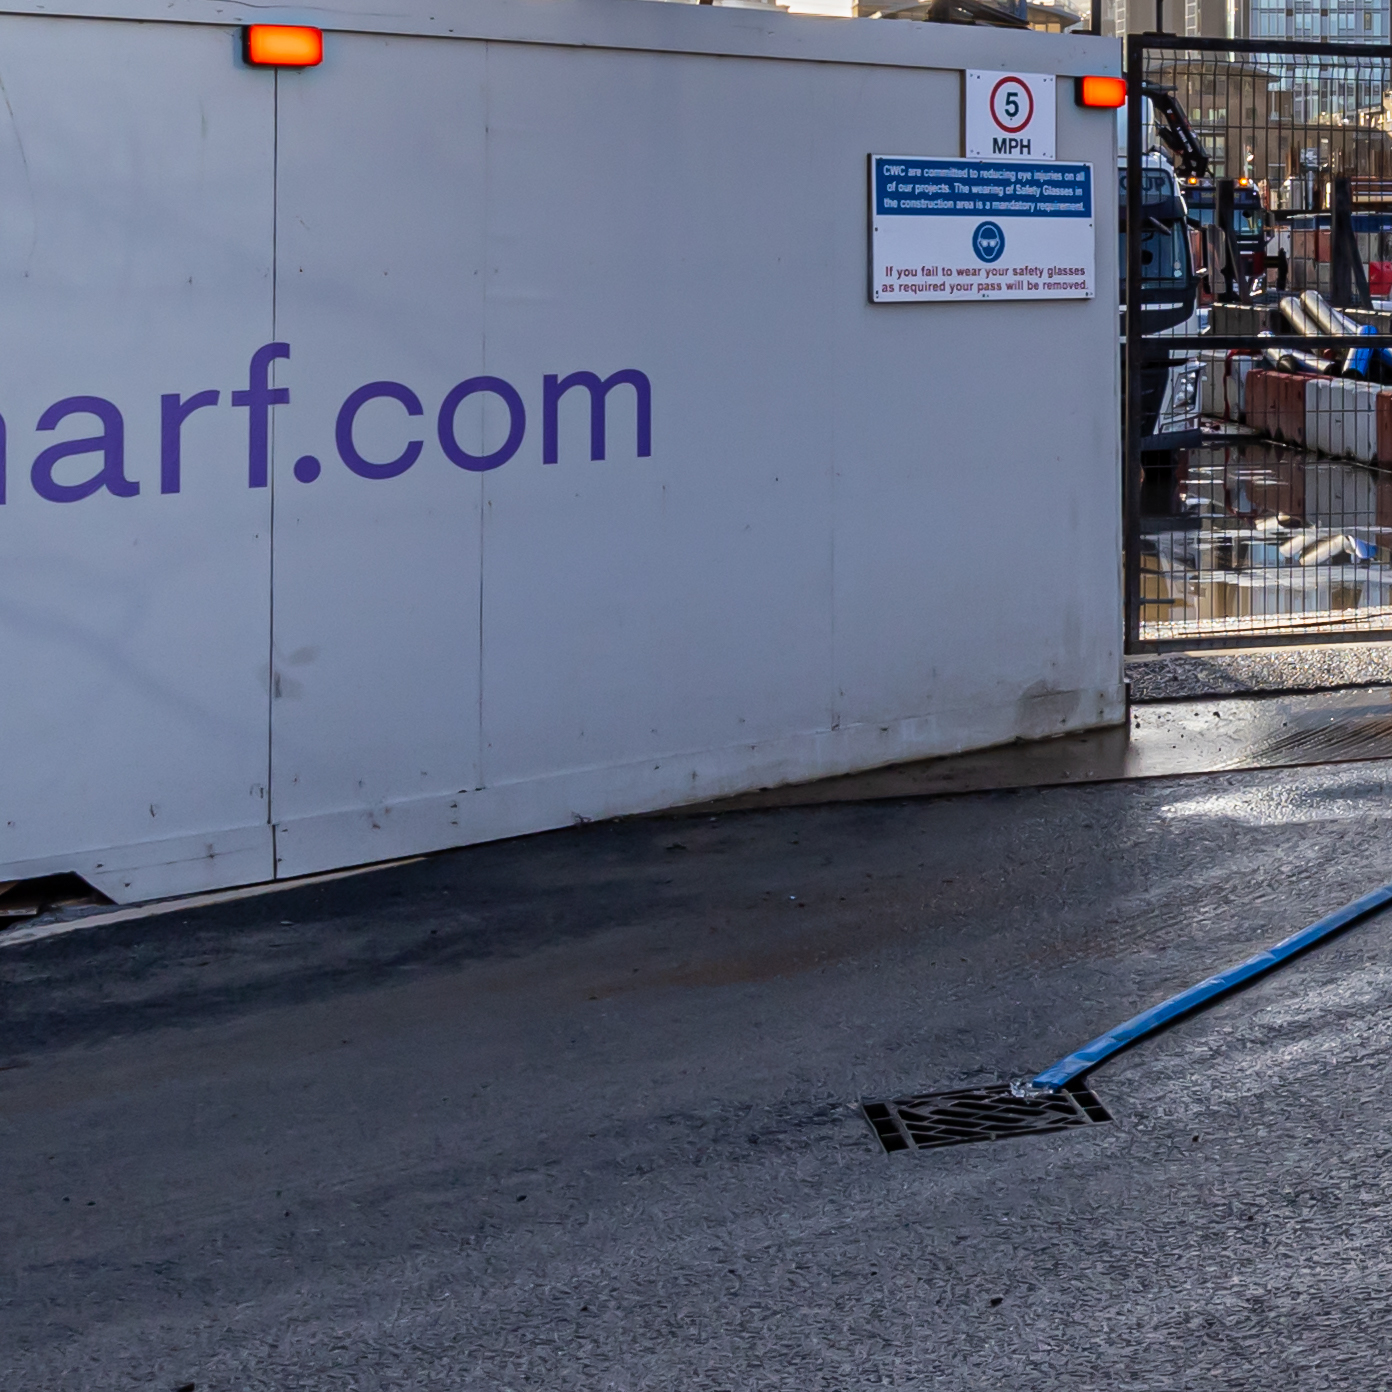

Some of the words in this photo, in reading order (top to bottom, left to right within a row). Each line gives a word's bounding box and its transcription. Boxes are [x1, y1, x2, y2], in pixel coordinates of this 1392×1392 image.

[1005, 92, 1019, 117] 5
[992, 138, 1031, 155] MPH
[883, 165, 906, 177] CWC
[924, 166, 968, 179] committed
[970, 168, 978, 178] to
[980, 169, 1016, 182] reducing
[1034, 170, 1062, 183] injuries
[887, 182, 896, 193] of
[898, 184, 913, 193] our
[954, 182, 969, 194] The
[971, 184, 1004, 196] wearing
[1005, 184, 1014, 195] of
[1016, 185, 1041, 198] Safety
[1042, 185, 1074, 196] Glasses
[1075, 186, 1082, 196] in
[884, 198, 898, 208] the
[900, 198, 954, 209] construction
[956, 201, 974, 209] area
[976, 198, 983, 209] is
[992, 200, 1035, 212] mandatory
[885, 266, 895, 277] If
[897, 269, 918, 279] you
[921, 265, 938, 277] fail
[941, 266, 953, 277] to
[956, 268, 982, 277] wear
[985, 268, 1009, 279] your
[1012, 265, 1044, 278] safety
[1047, 265, 1085, 278] glasses
[881, 284, 895, 293] as
[898, 281, 946, 294] required
[949, 283, 974, 294] your
[977, 283, 1002, 294] pass
[1006, 280, 1024, 291] will
[1027, 280, 1039, 290] be
[1042, 280, 1088, 291] removed.
[0, 341, 652, 505] arf.com
